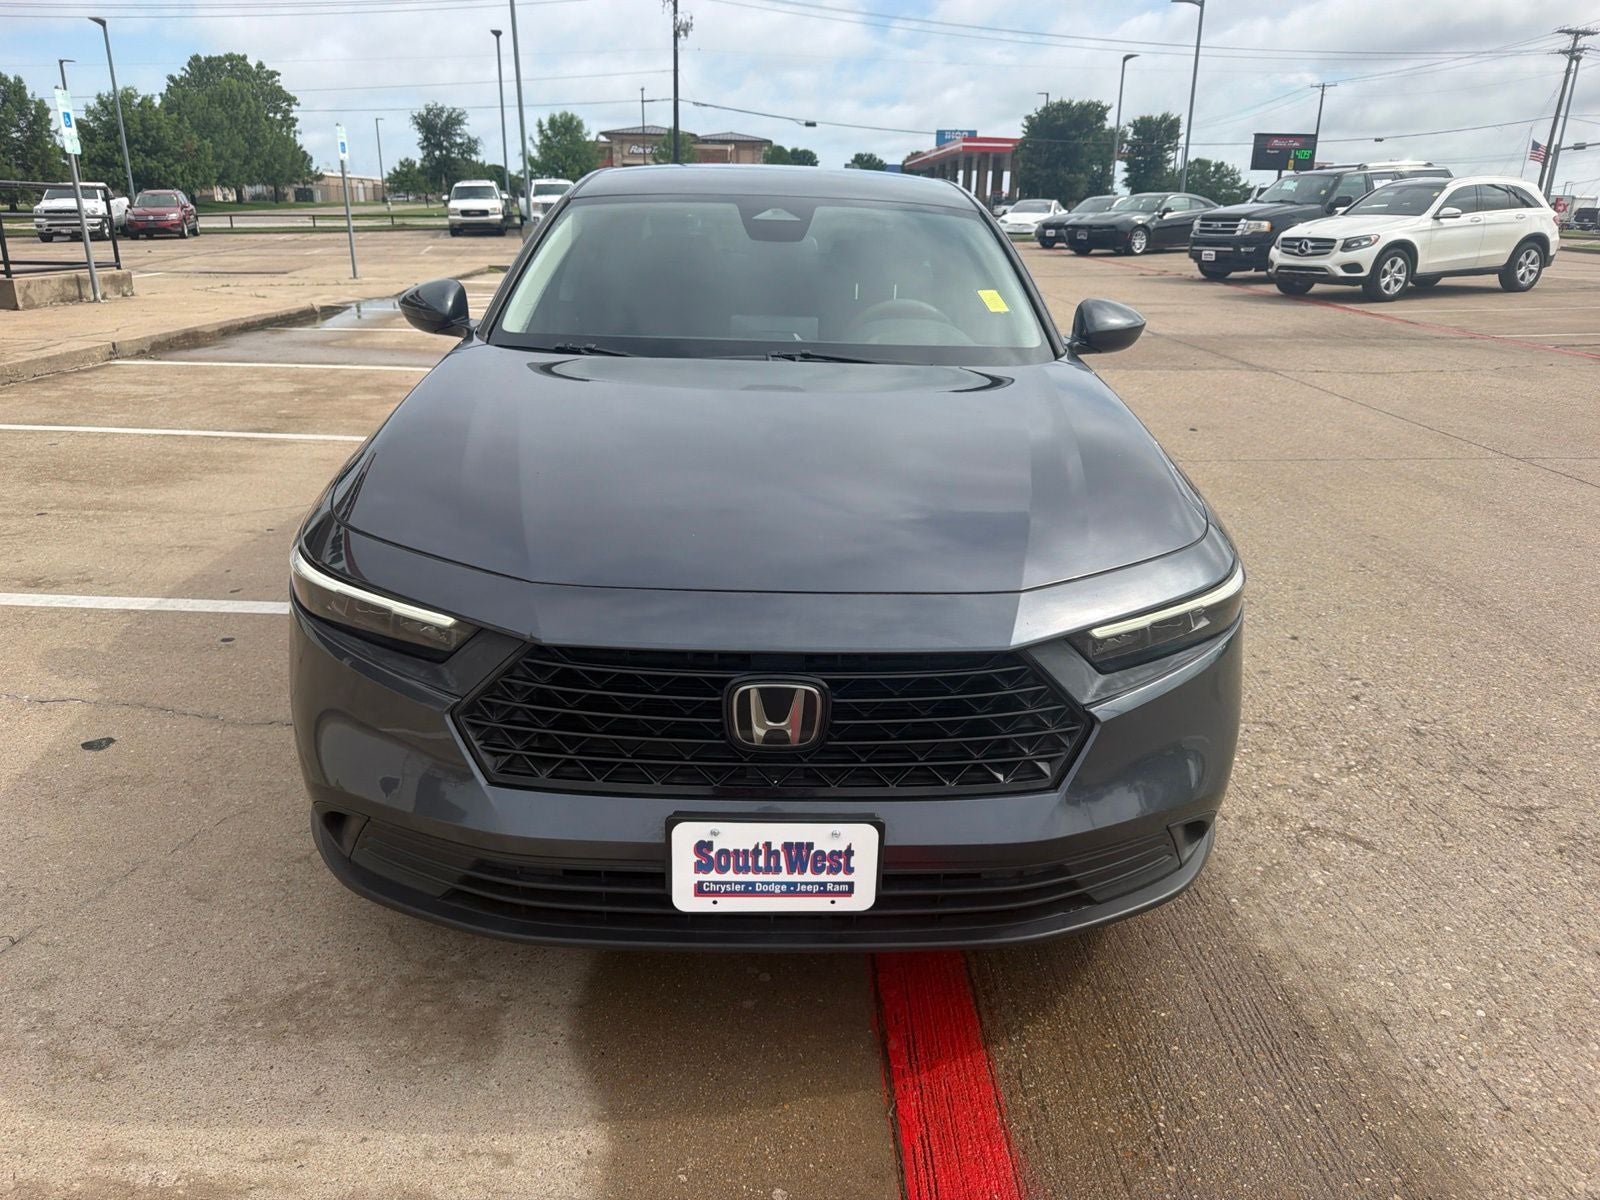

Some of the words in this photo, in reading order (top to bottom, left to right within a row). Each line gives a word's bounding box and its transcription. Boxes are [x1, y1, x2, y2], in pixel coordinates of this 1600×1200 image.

[693, 840, 855, 876] SouthWest
[703, 882, 746, 894] Chrysler
[755, 882, 787, 894] Dodge
[796, 882, 819, 894] Jeep
[826, 882, 849, 892] Ram
